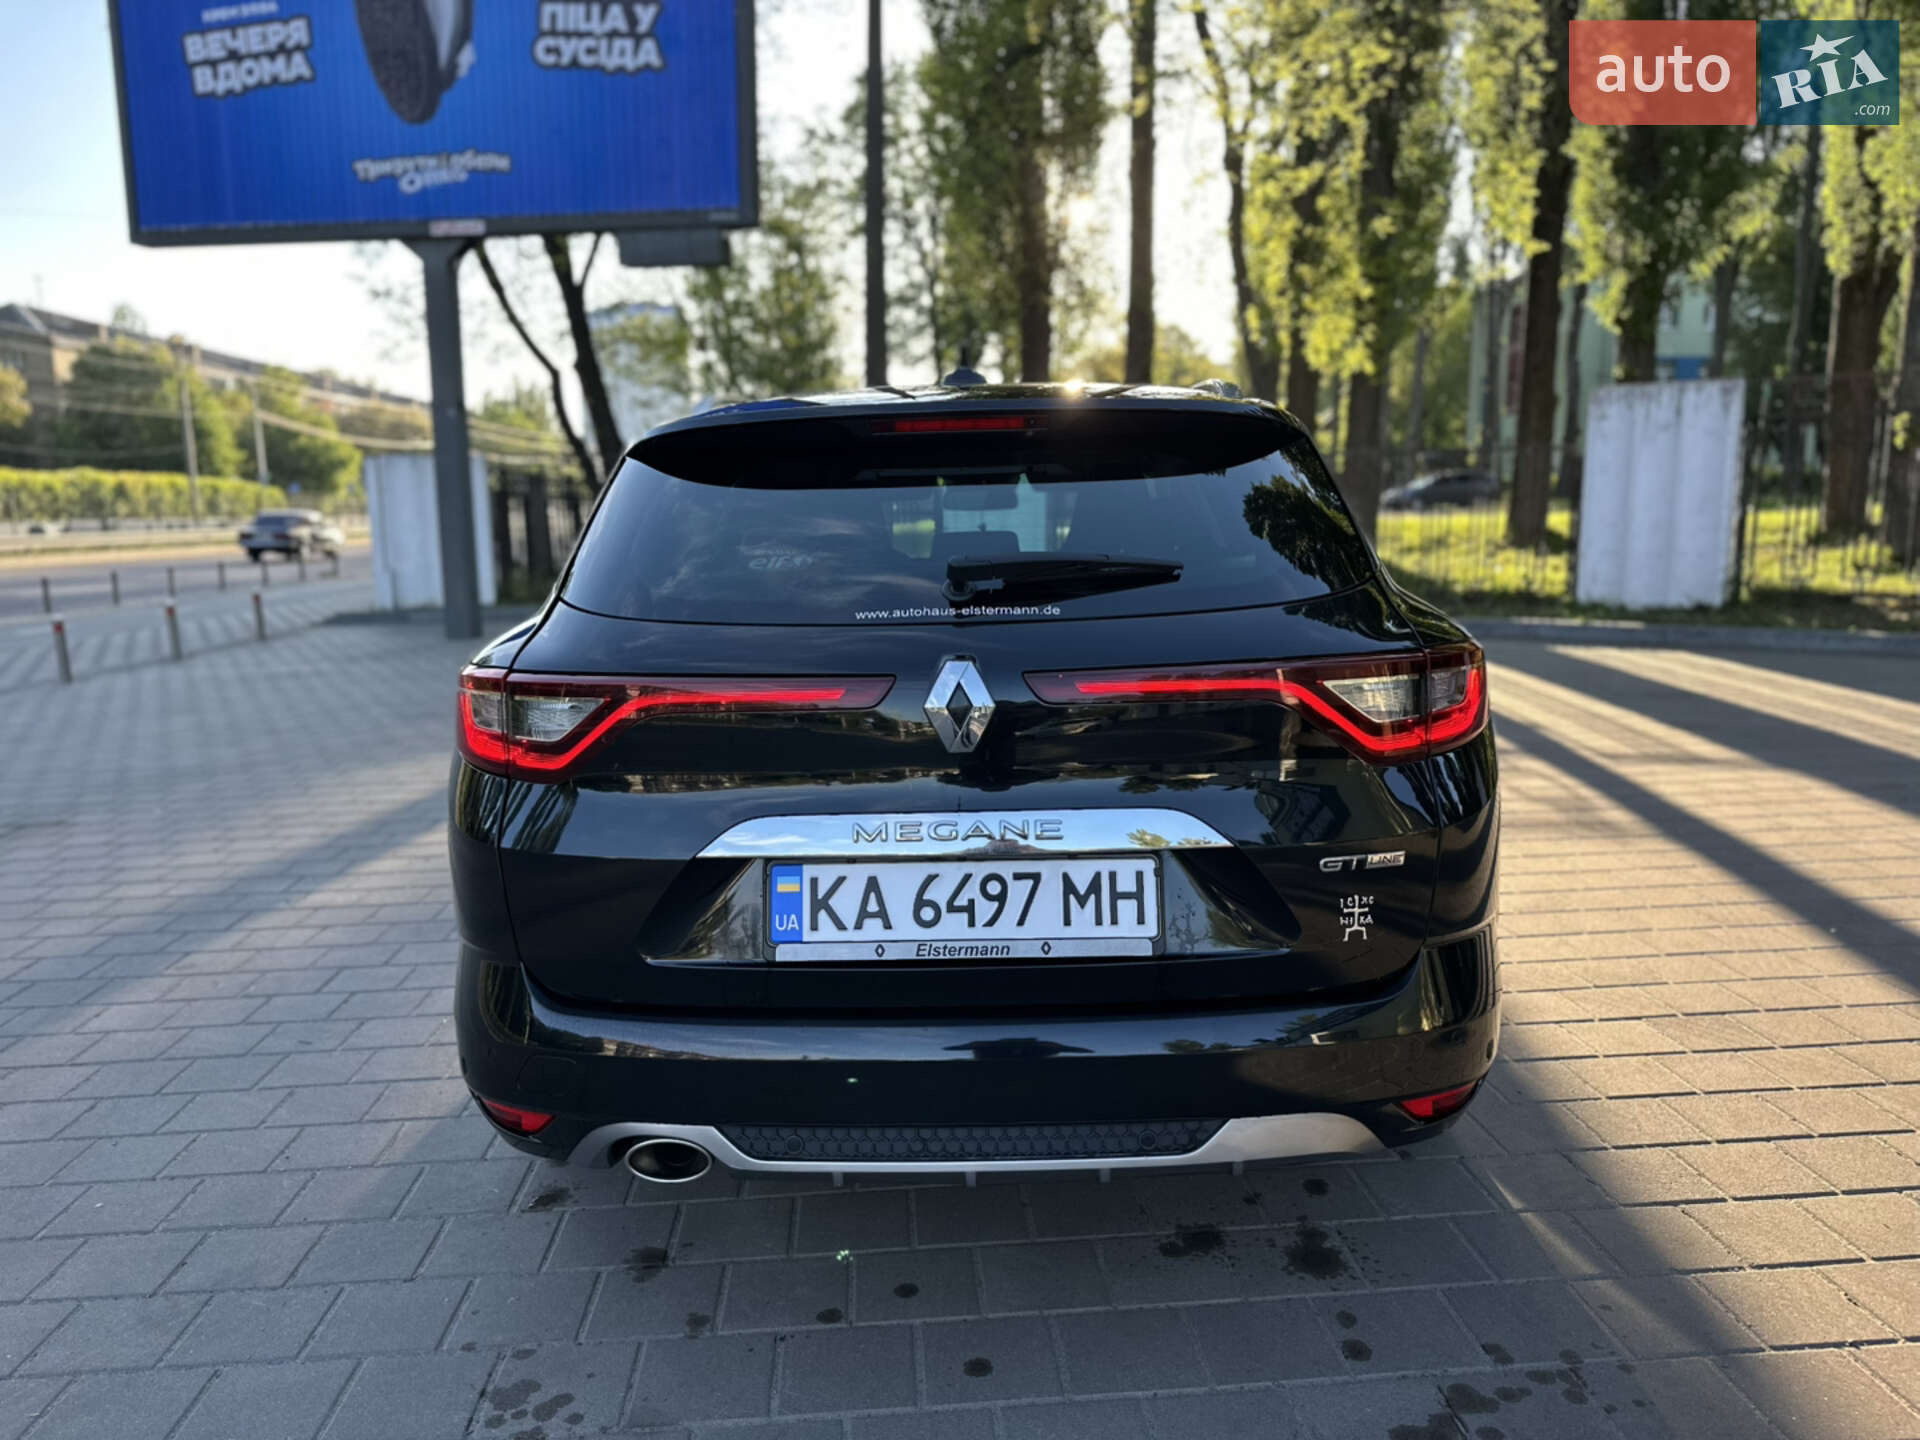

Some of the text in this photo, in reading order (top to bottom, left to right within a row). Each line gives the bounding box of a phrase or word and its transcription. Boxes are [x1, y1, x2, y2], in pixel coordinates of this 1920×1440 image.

[632, 3, 660, 35] У
[183, 17, 310, 63] ВЕЧЕРЯ
[533, 35, 664, 73] СУСІДА
[192, 50, 314, 96] ВДОМА
[855, 604, 1061, 620] www.autohaus-elstermann.de
[852, 819, 1065, 844] MEGANE
[1319, 854, 1366, 872] GT
[809, 869, 1146, 932] KA 6497 MH
[775, 914, 799, 932] UA
[915, 942, 1011, 959] Elstermann
